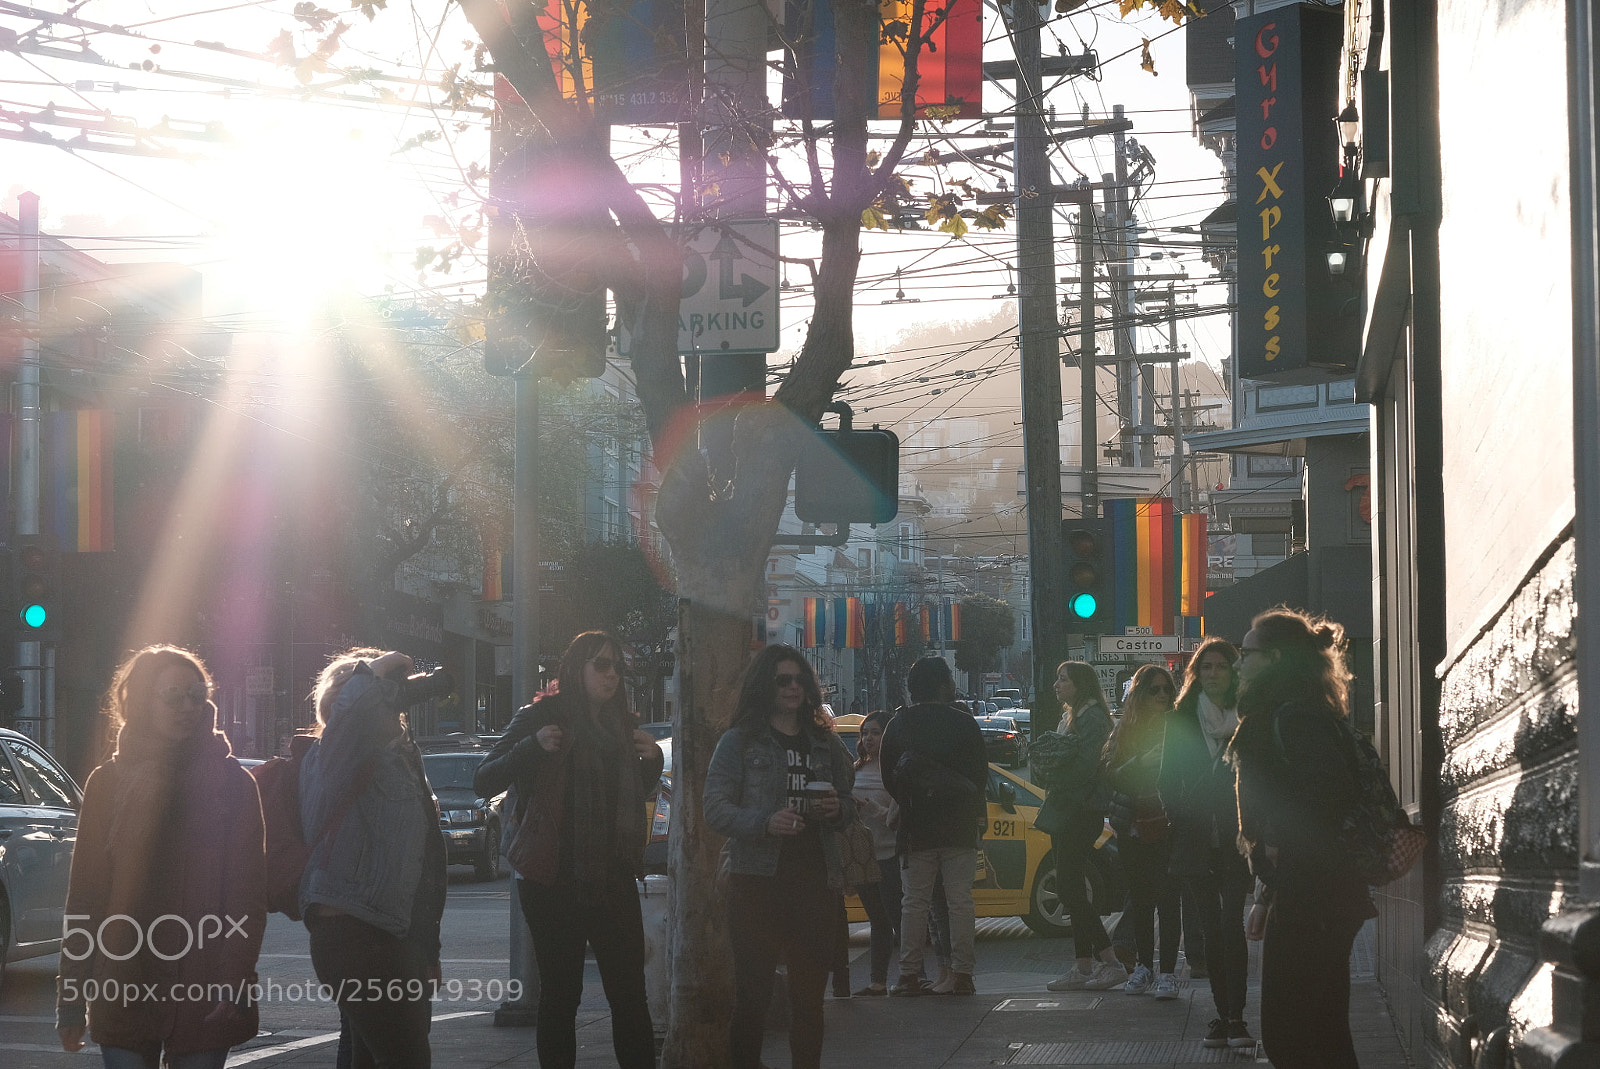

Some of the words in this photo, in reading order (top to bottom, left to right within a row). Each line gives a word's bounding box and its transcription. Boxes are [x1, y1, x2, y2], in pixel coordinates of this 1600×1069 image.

[1256, 23, 1280, 150] Gyro
[1255, 161, 1284, 361] Xpress
[678, 310, 765, 332] ARKING
[1135, 627, 1151, 635] 500
[1116, 640, 1163, 651] Castro
[993, 820, 1016, 837] 921
